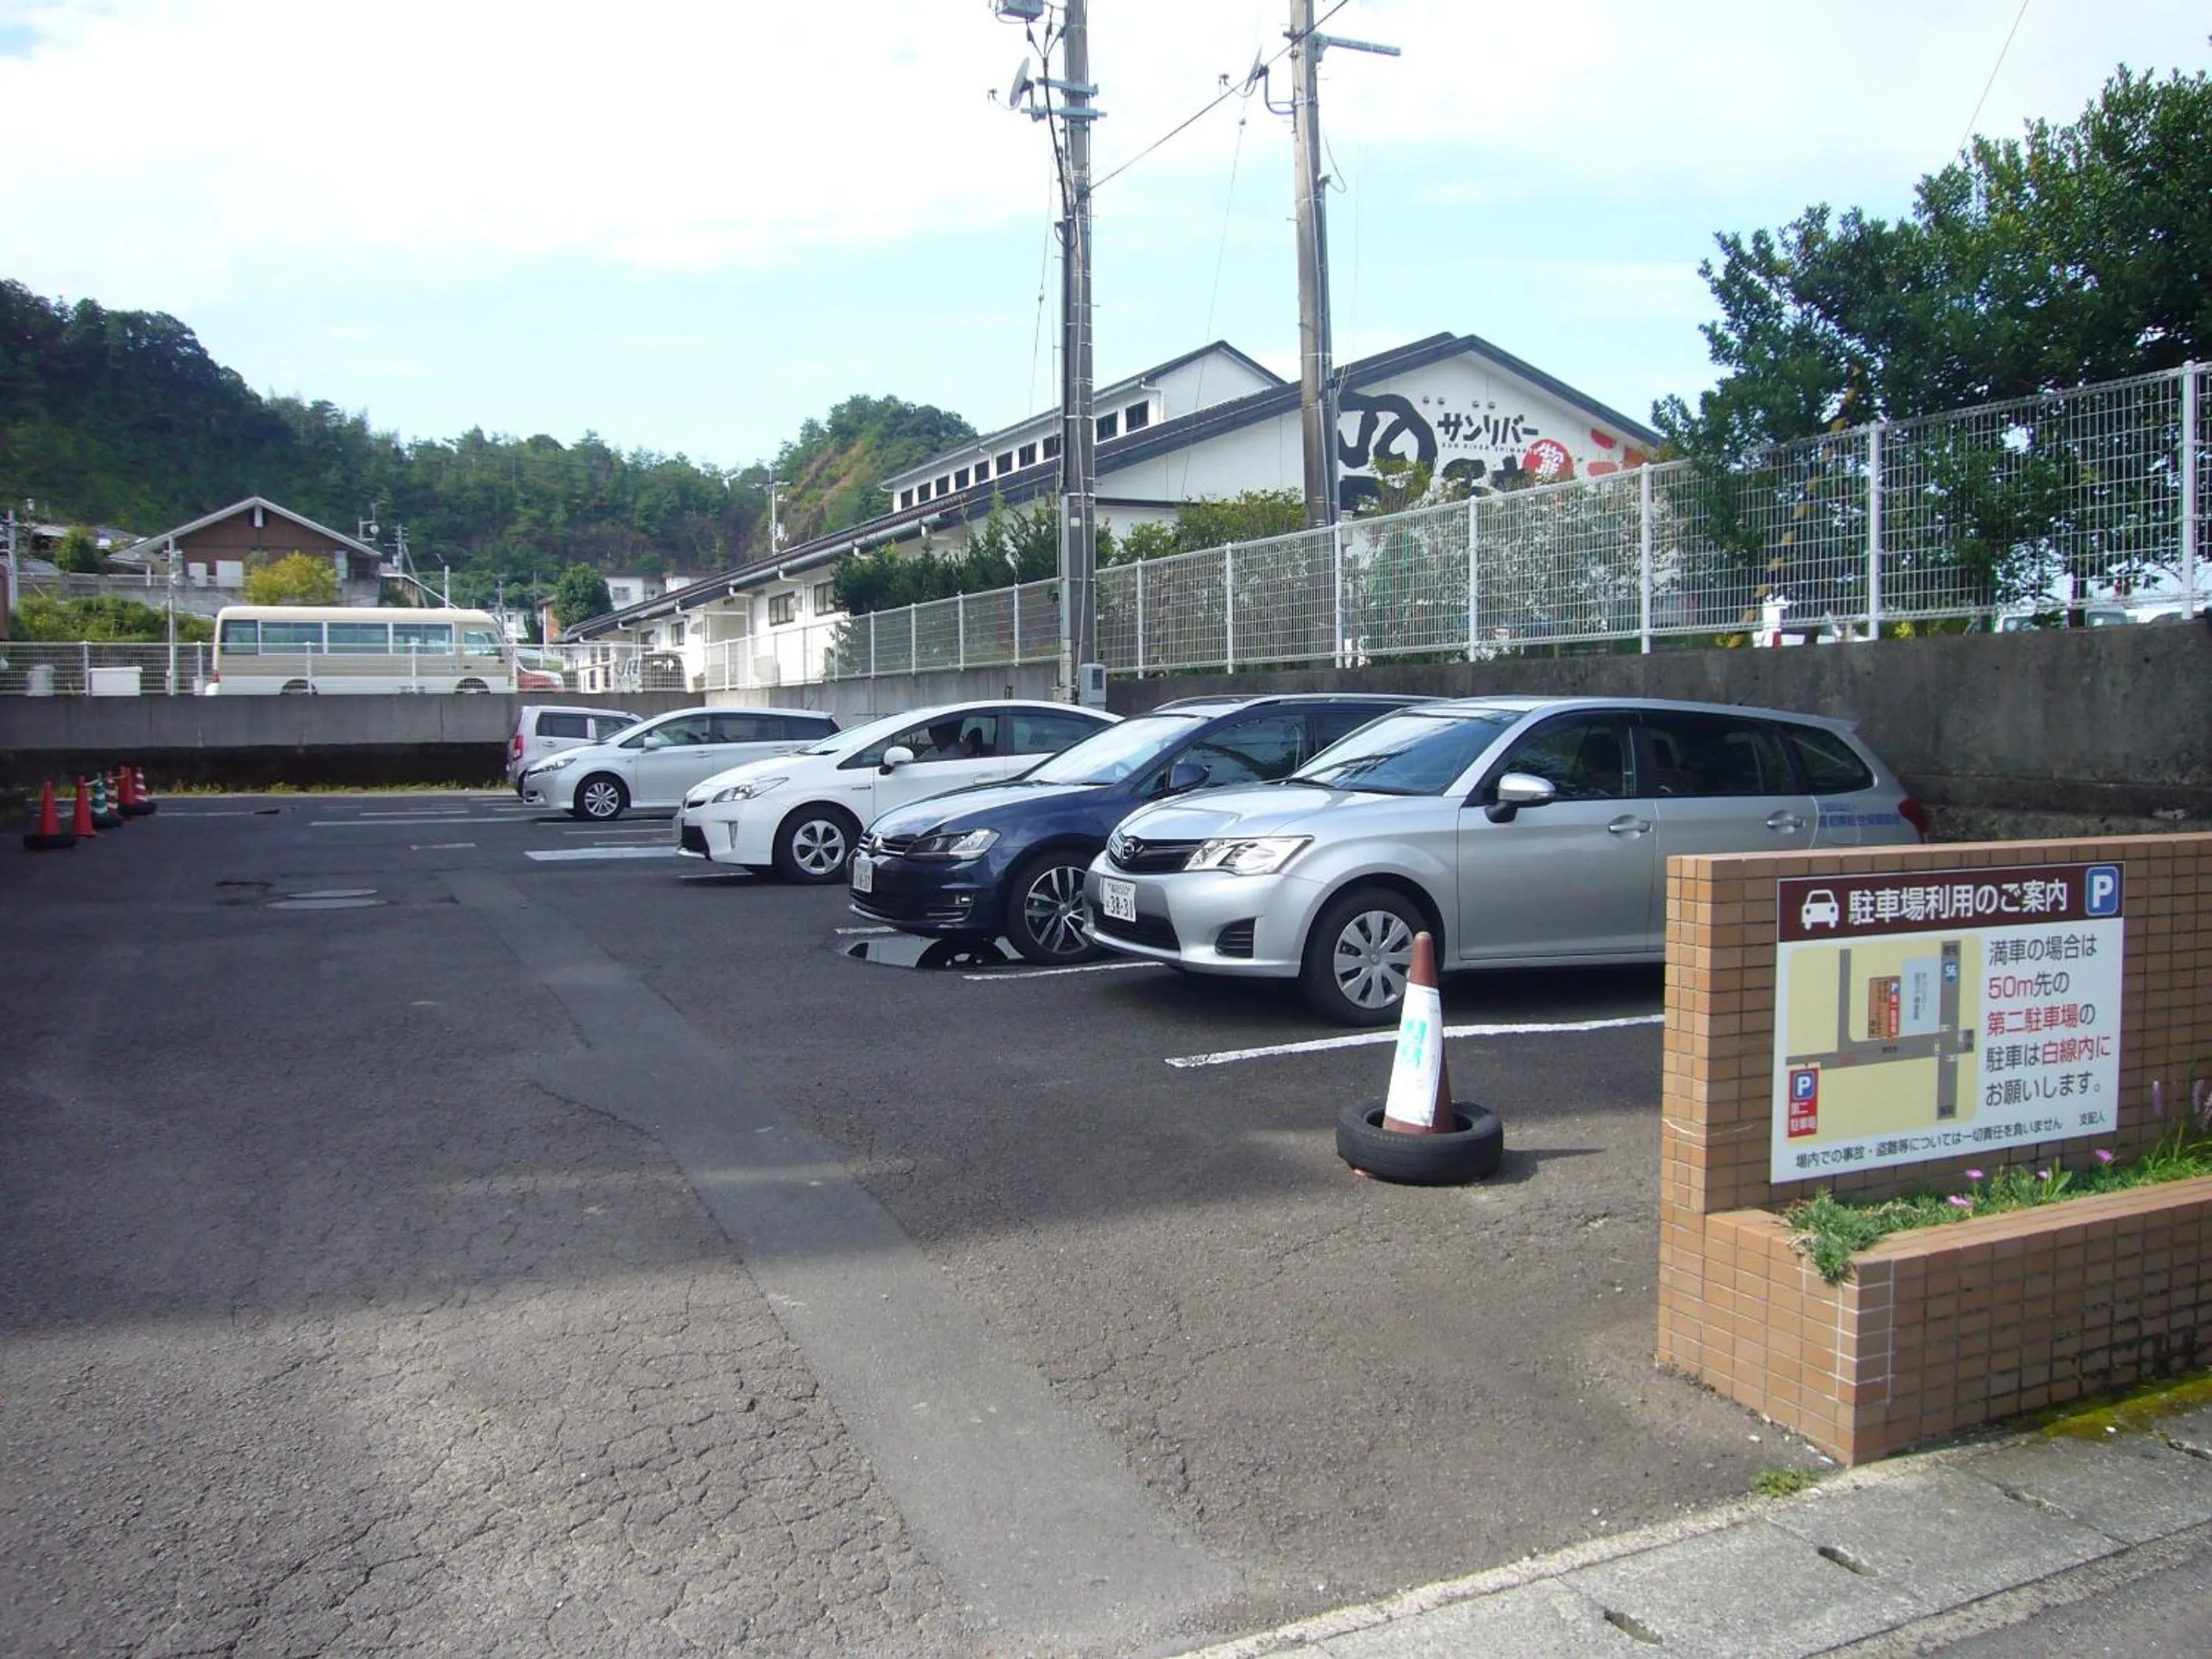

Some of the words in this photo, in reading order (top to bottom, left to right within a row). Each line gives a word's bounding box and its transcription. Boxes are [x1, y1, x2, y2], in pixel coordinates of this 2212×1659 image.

[1437, 412, 1539, 445] サンリバー
[1848, 878, 2067, 926] 駐車場利用のご案内
[2093, 874, 2114, 908] P
[1989, 933, 2098, 967] 満車の場合は
[1988, 971, 2071, 999] 50m先の
[1987, 1003, 2097, 1037] 第二駐車場の
[1985, 1035, 2111, 1073] 駐車は白線内に
[1796, 1075, 1811, 1097] P
[1985, 1070, 2101, 1107] お願いします。
